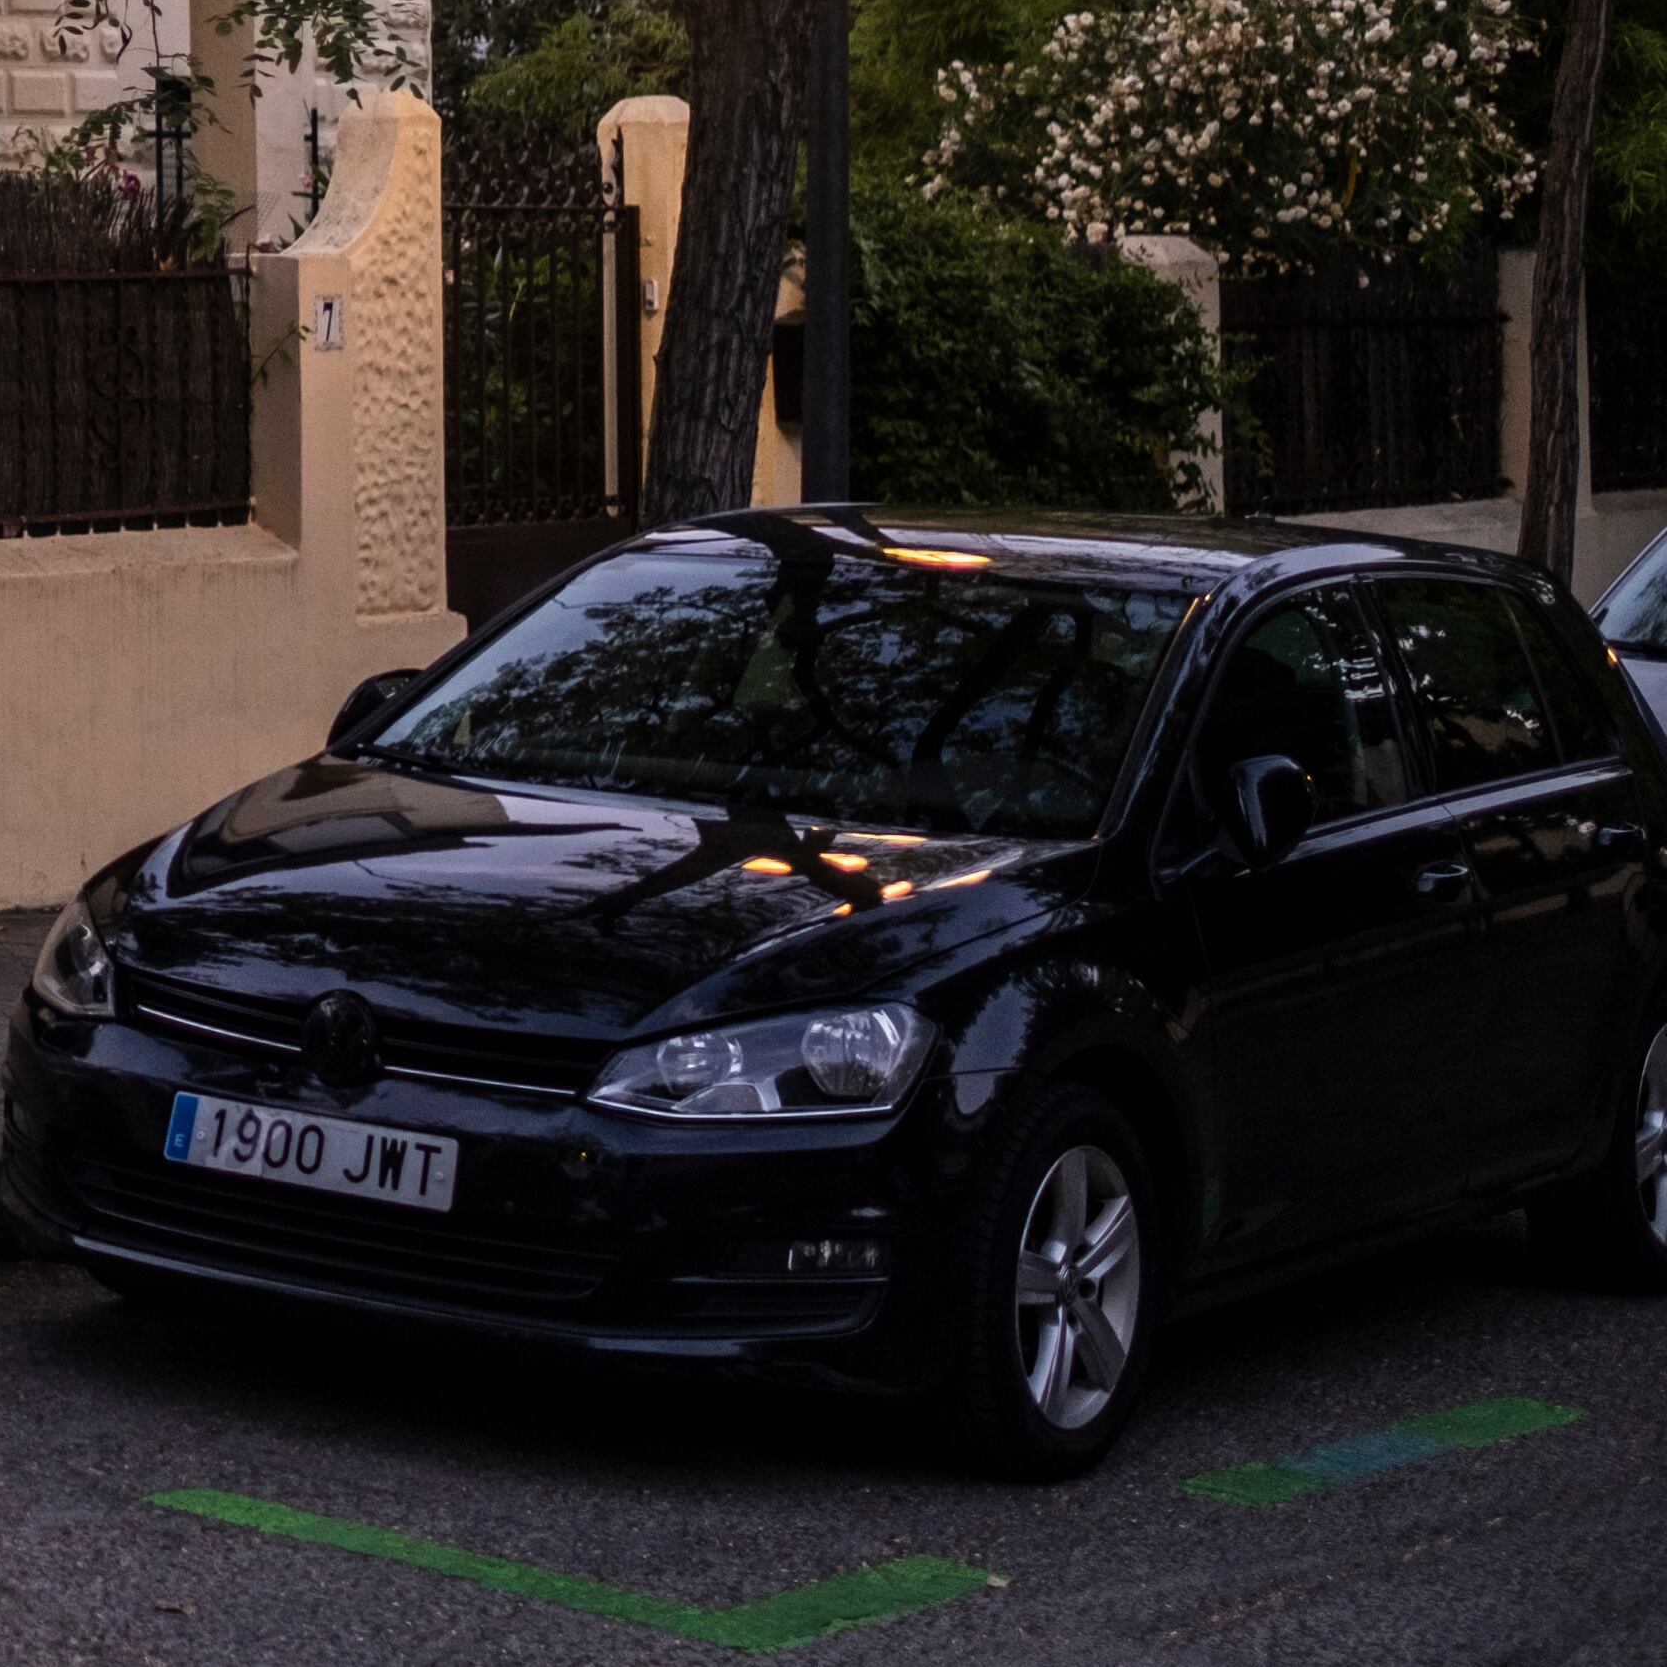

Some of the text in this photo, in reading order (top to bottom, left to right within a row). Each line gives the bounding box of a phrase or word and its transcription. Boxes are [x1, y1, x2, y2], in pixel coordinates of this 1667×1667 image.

[322, 301, 334, 342] 7
[211, 1108, 442, 1196] 1900 JWT
